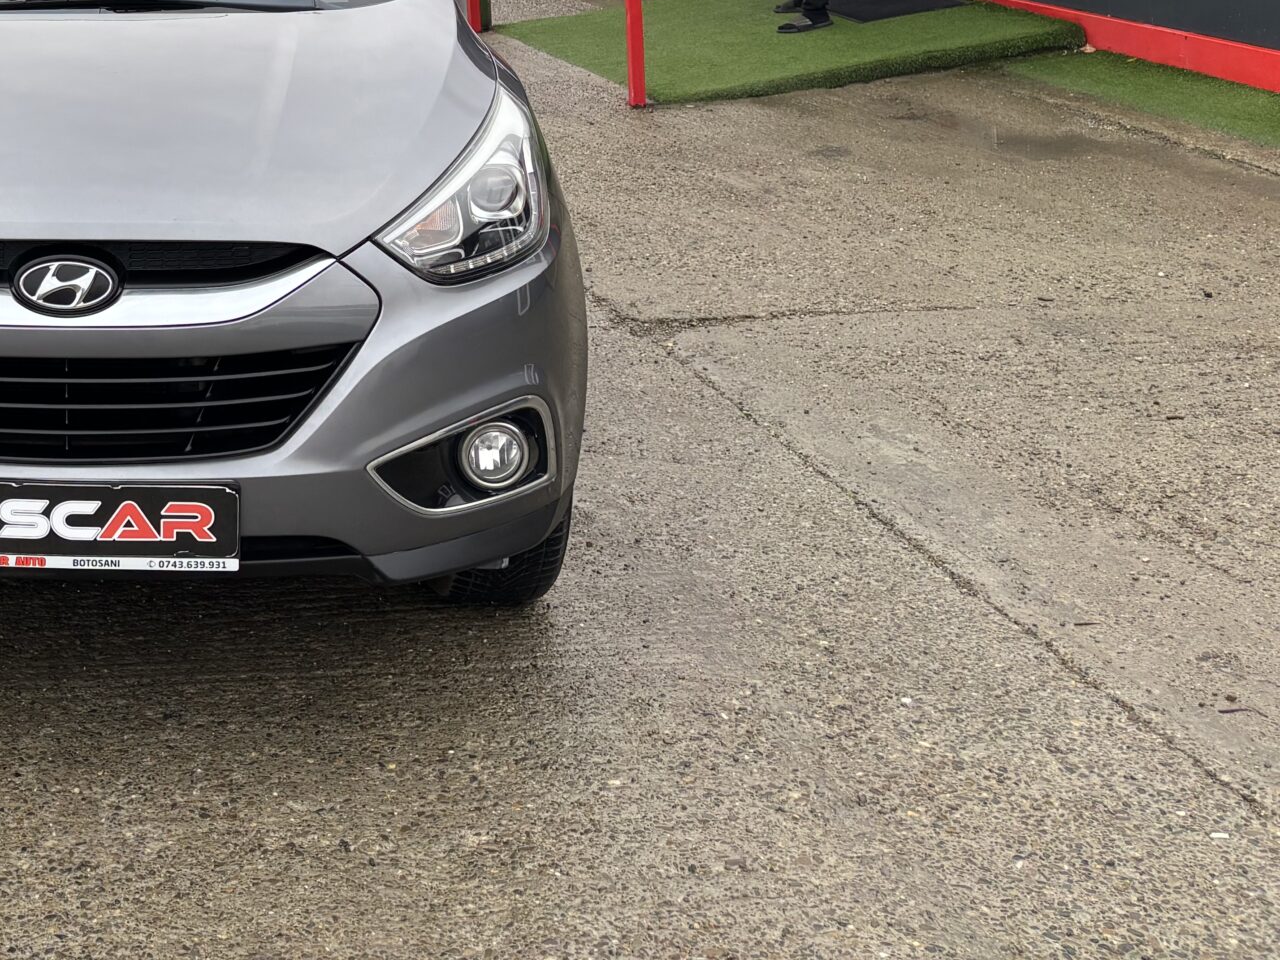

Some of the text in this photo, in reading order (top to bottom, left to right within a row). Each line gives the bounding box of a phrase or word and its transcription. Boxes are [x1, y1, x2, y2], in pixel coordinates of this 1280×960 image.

[14, 556, 47, 567] AUTO
[72, 558, 121, 568] BOTOSANI
[158, 560, 227, 569] 0743.639.931
